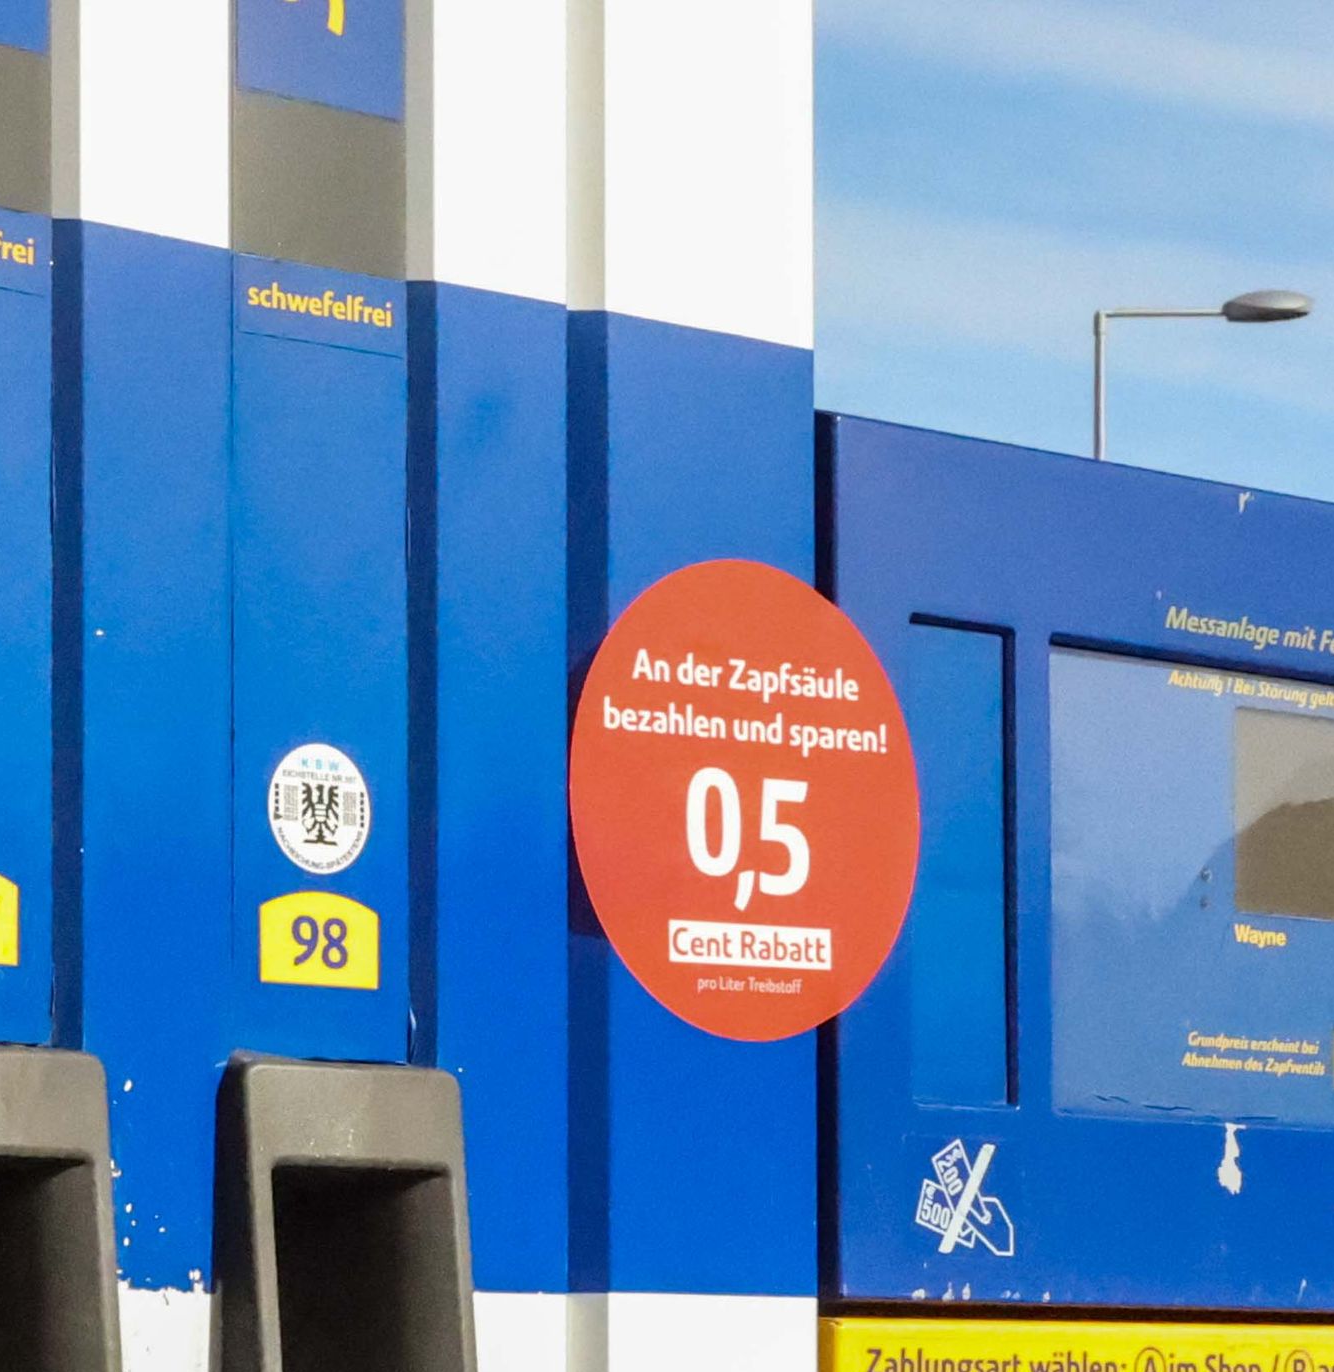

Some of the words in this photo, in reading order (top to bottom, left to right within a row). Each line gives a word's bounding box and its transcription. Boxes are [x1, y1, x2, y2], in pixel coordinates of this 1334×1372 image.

[248, 283, 392, 327] schwefelfrei
[1166, 606, 1279, 650] Messanlage
[1283, 627, 1315, 650] mit
[632, 648, 670, 684] An
[677, 652, 721, 688] der
[729, 659, 859, 702] Zapfsäule
[1234, 678, 1255, 695] Bei
[604, 696, 726, 738] bezahlen
[733, 714, 783, 745] und
[789, 724, 889, 757] sparen!
[686, 767, 810, 911] 0,5
[291, 915, 348, 969] 98
[672, 927, 732, 957] Cent
[740, 929, 827, 963] Rabatt
[1234, 924, 1287, 948] Wayne
[697, 978, 717, 993] pro
[718, 977, 746, 993] Liter
[747, 978, 802, 995] Treibstoff
[1188, 1031, 1248, 1052] Grundpreis
[1250, 1037, 1299, 1053] erscheint
[1301, 1040, 1319, 1054] bei
[1182, 1051, 1242, 1069] Abnehmen
[1244, 1056, 1263, 1071] des
[1265, 1058, 1325, 1077] Zapfventils
[937, 1160, 965, 1196] 200
[921, 1200, 951, 1229] 500
